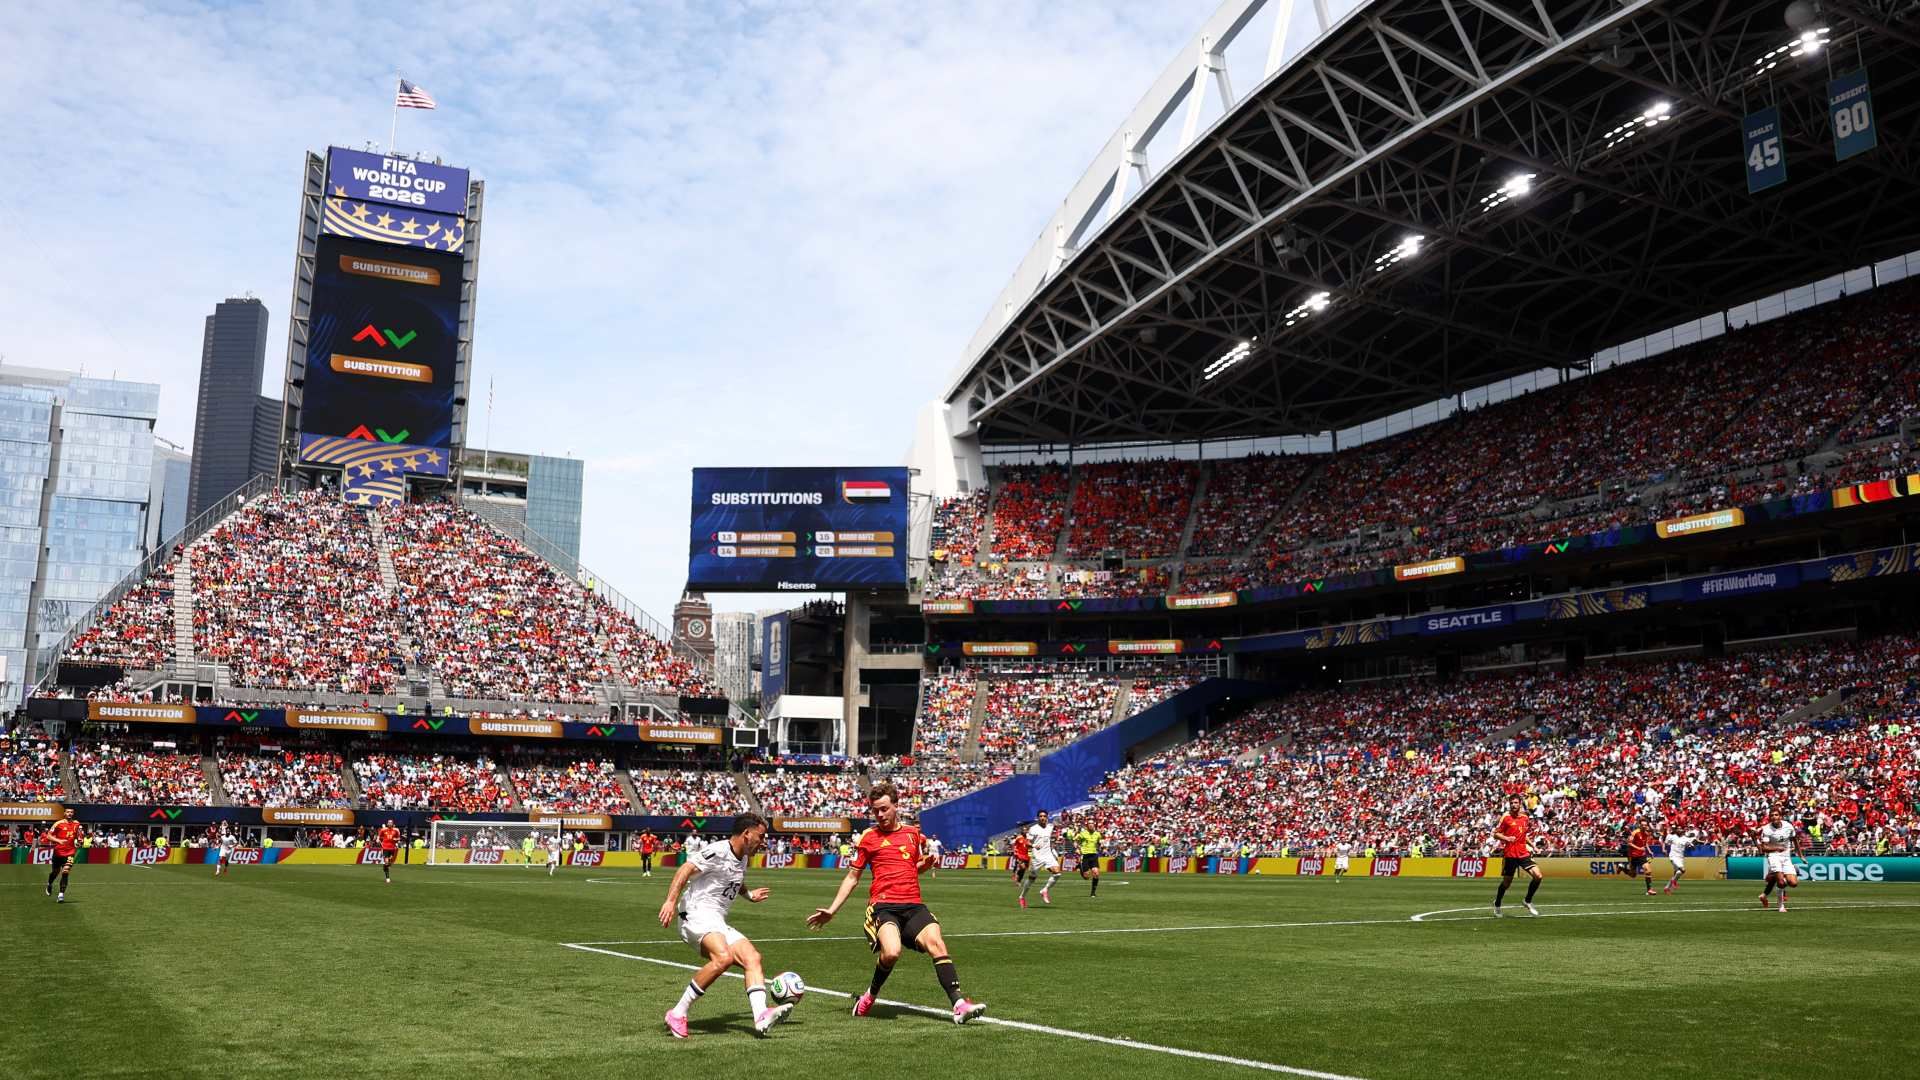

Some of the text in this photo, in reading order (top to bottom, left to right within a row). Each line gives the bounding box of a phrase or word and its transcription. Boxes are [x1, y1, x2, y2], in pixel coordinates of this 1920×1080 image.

[1835, 101, 1869, 138] 80
[1748, 136, 1780, 172] 45
[382, 158, 417, 176] FIFA
[352, 167, 447, 194] WORLD CUP
[368, 185, 426, 205] 2026
[352, 261, 428, 280] SUBSTITUTION
[343, 360, 421, 377] SUBSTITUTION
[711, 492, 822, 505] SUBSTITUTIONS
[1666, 514, 1733, 533] SUBSTITUTION
[1403, 560, 1456, 577] SUBSTITUTION
[777, 581, 816, 590] Hisense
[1702, 572, 1777, 594] #FIFAWorldCup
[1175, 596, 1231, 608] SUBSTITUTION
[1427, 611, 1502, 630] SEATTLE
[1118, 643, 1175, 651] SUBSTITUTION
[99, 707, 183, 719] SUBSTITUTION
[298, 714, 375, 727] SUBSTITUTION
[481, 722, 552, 734] SUBSTITUTION
[649, 729, 715, 740] SUBSTITUTION
[0, 807, 52, 816] TITUTION
[274, 812, 343, 821] SUBSTITUTION
[783, 821, 841, 830] SUBSTITUTION
[131, 847, 167, 864] Lay's
[228, 847, 259, 864] Lay's
[469, 849, 500, 865] Lay's
[571, 850, 601, 866] Lay's
[766, 853, 793, 868] Lay's
[898, 845, 910, 860] 5
[941, 854, 966, 868] Lay's
[1300, 857, 1323, 875] Lay's
[1373, 858, 1399, 876] Lay's
[1456, 858, 1484, 877] Lay's
[1763, 858, 1883, 881] sense
[722, 881, 740, 900] 25
